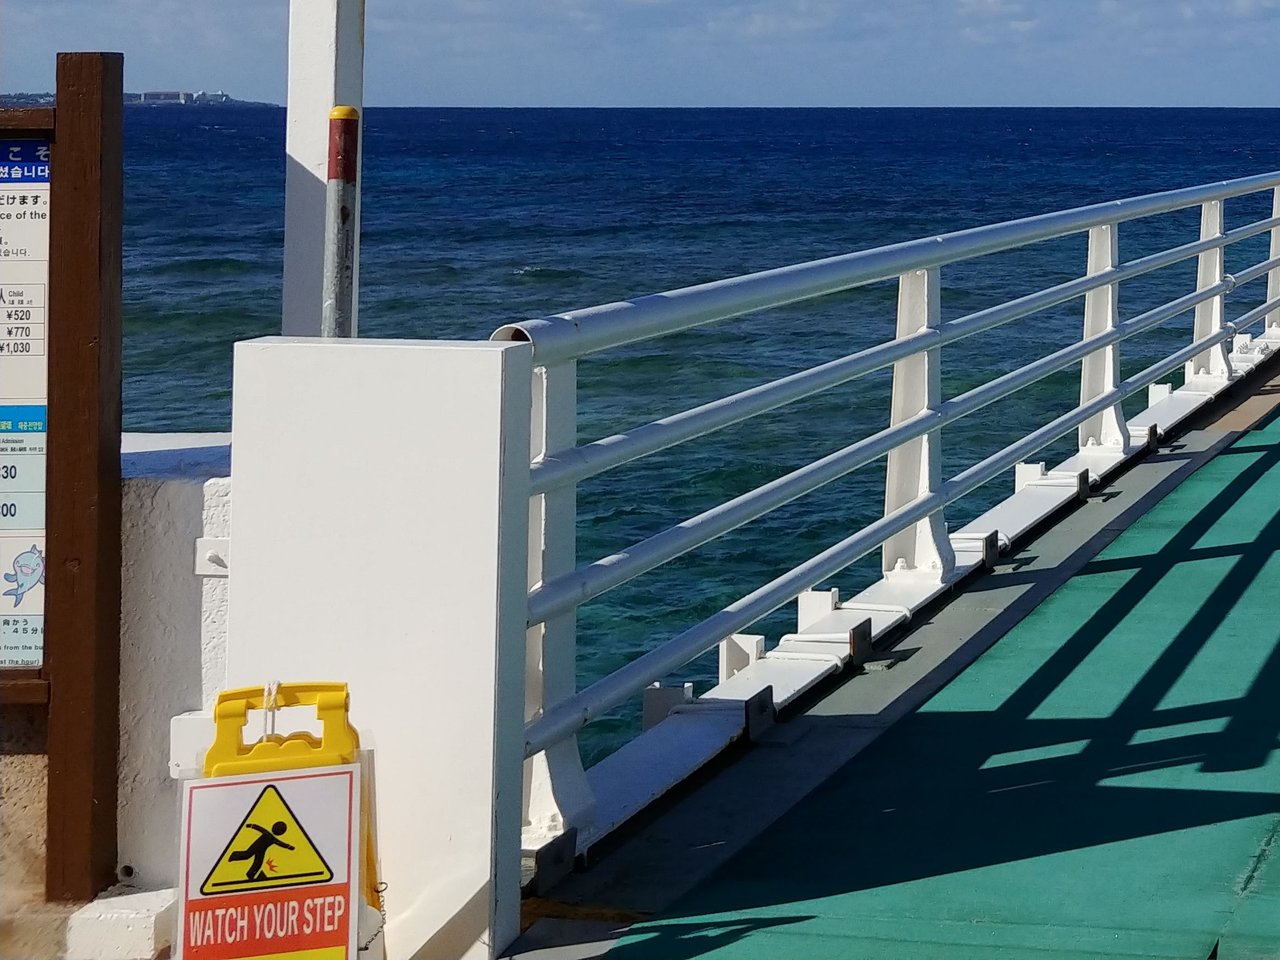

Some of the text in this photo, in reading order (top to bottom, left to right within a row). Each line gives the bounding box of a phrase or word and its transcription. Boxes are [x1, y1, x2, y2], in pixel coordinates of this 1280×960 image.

[15, 210, 27, 220] of
[29, 210, 47, 220] the
[6, 309, 31, 321] ¥520
[6, 326, 31, 338] ¥770
[0, 342, 31, 354] ¥1,030
[0, 503, 17, 517] 00
[189, 894, 345, 947] WATCH YOUR STEP
